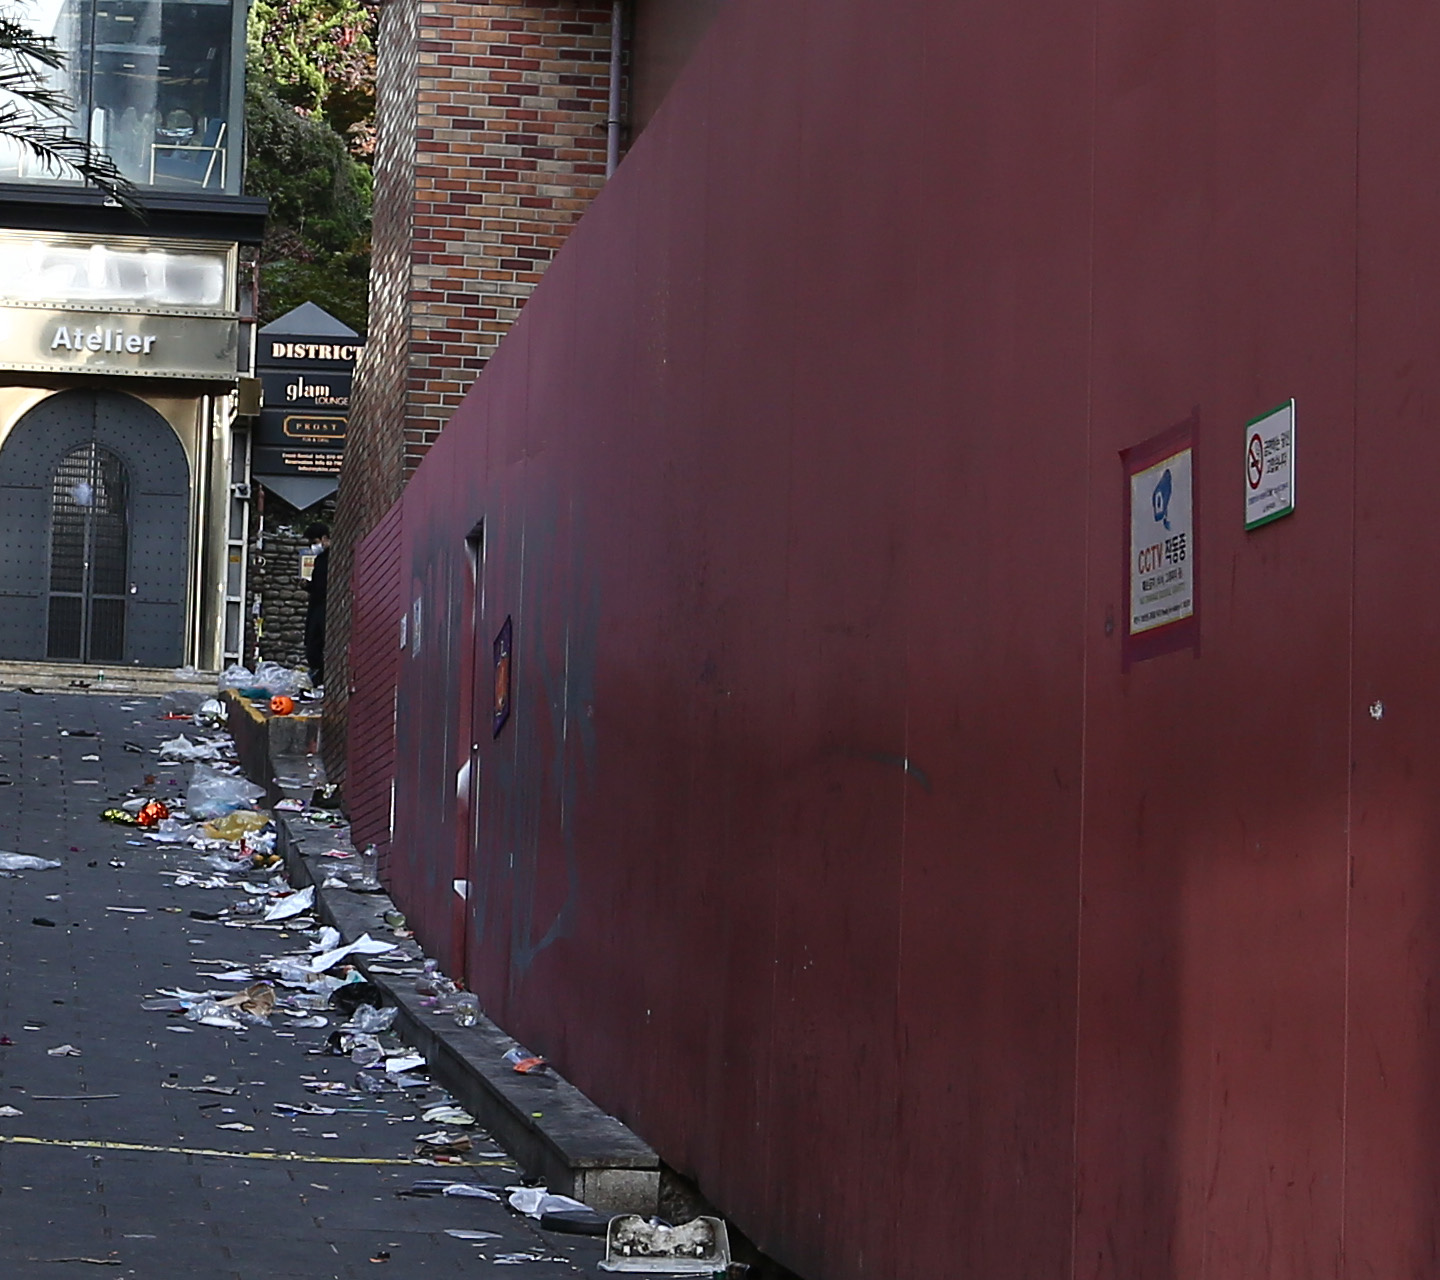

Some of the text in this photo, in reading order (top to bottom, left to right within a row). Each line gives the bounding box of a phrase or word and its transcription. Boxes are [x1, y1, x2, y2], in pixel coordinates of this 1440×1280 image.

[51, 325, 157, 355] Atelier
[272, 342, 366, 361] DISTRICT
[286, 376, 330, 402] glam
[315, 397, 350, 406] LOUNGE
[1138, 542, 1164, 575] CCTV
